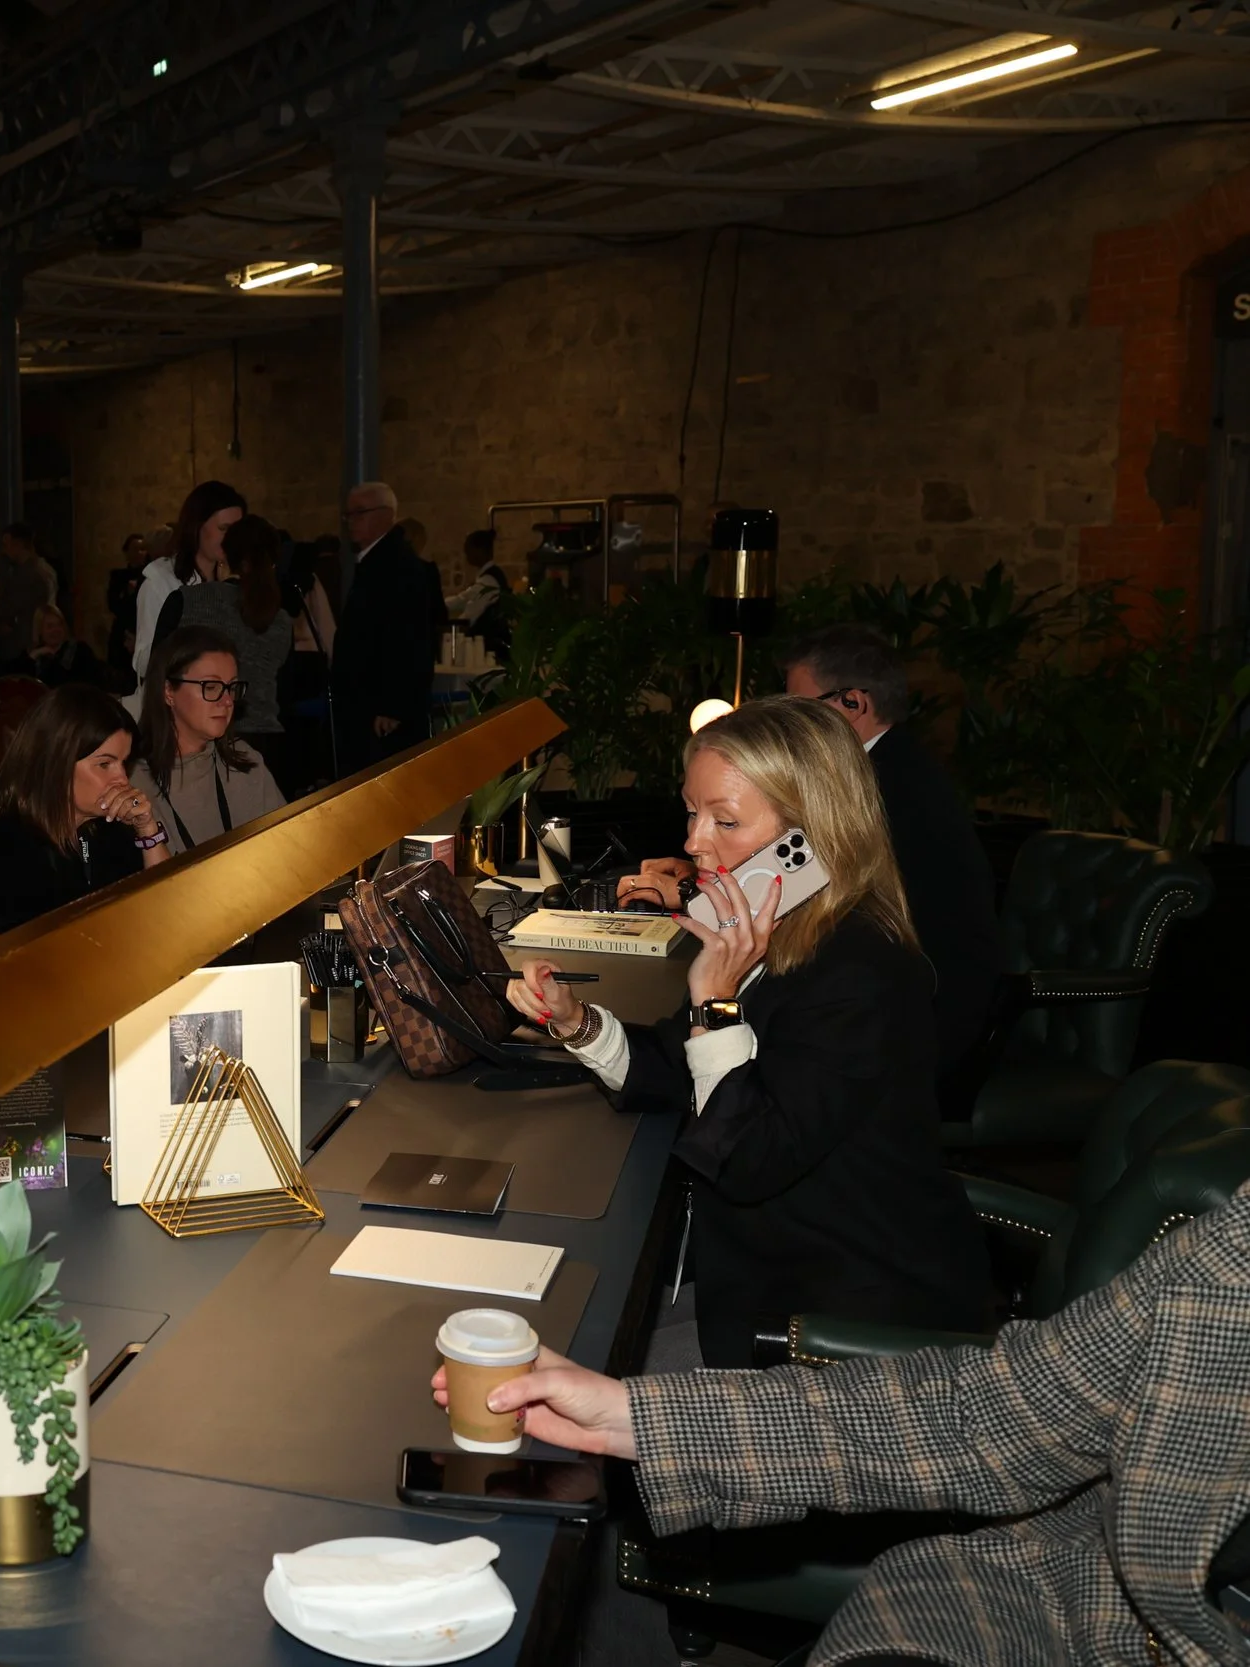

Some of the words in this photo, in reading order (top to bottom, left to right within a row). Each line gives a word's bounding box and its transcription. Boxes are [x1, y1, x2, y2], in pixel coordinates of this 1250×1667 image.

[550, 937, 576, 948] LIVE
[578, 939, 642, 953] BEAUTIFUL
[18, 1165, 54, 1177] ICONIC
